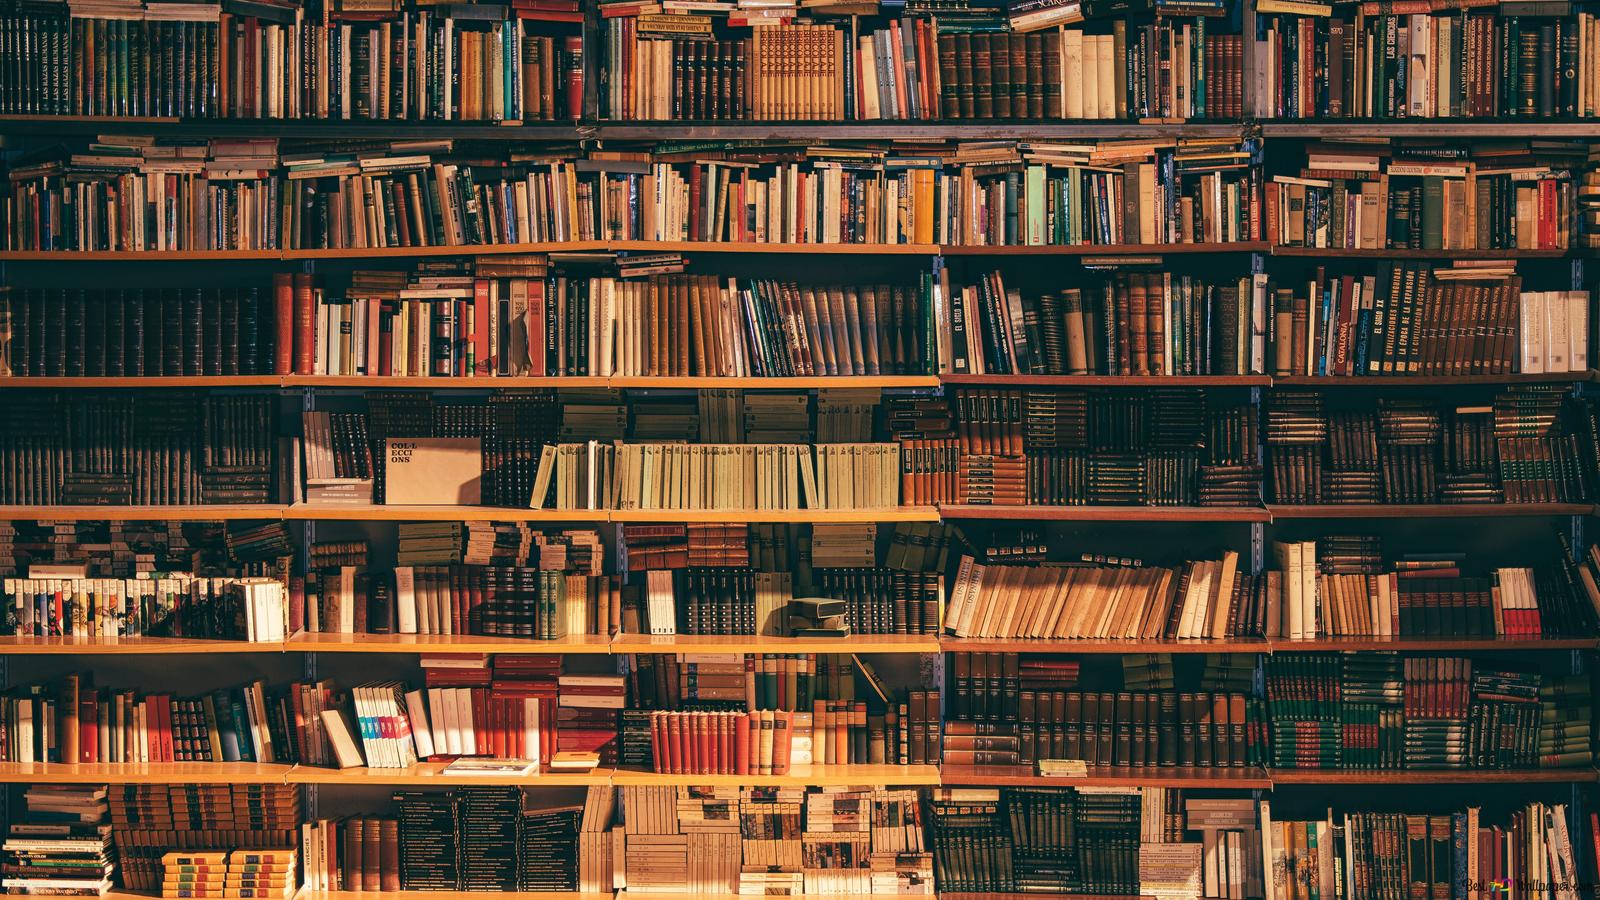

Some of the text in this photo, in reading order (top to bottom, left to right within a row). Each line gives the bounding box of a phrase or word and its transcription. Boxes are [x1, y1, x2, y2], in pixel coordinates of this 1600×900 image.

[1386, 17, 1396, 59] LAS CIENCIAS
[1416, 270, 1427, 305] OCCIDENTAL
[1375, 311, 1383, 325] SIGLO
[1386, 268, 1401, 355] CIVILIZACIONES EXTINGUIDAS
[1338, 322, 1348, 364] CATALONIA
[956, 561, 970, 595] PARNASO
[966, 570, 982, 604] PARNASO
